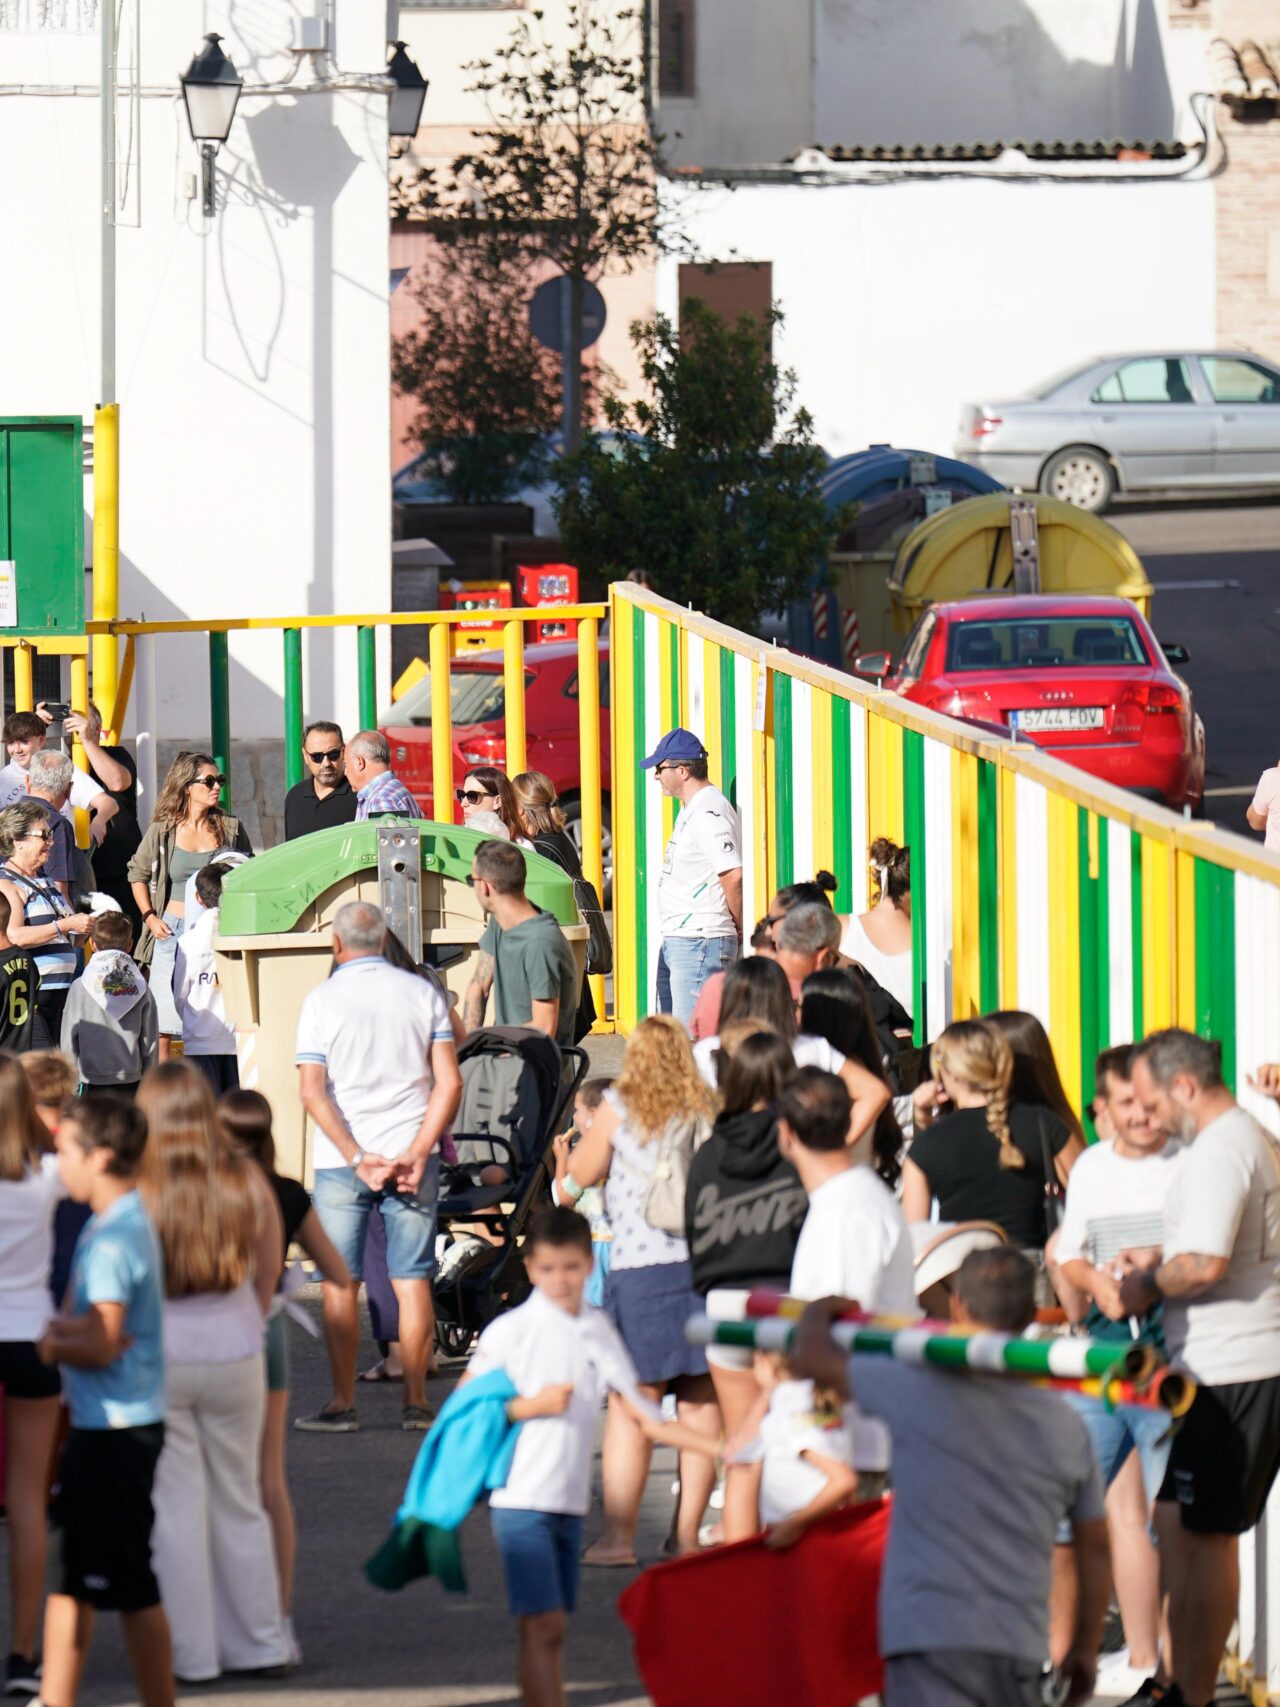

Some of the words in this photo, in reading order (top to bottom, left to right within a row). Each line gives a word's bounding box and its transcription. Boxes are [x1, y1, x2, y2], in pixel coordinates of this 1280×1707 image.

[1023, 708, 1064, 726] 5744
[3, 958, 28, 976] KOKE
[9, 979, 29, 1026] 6
